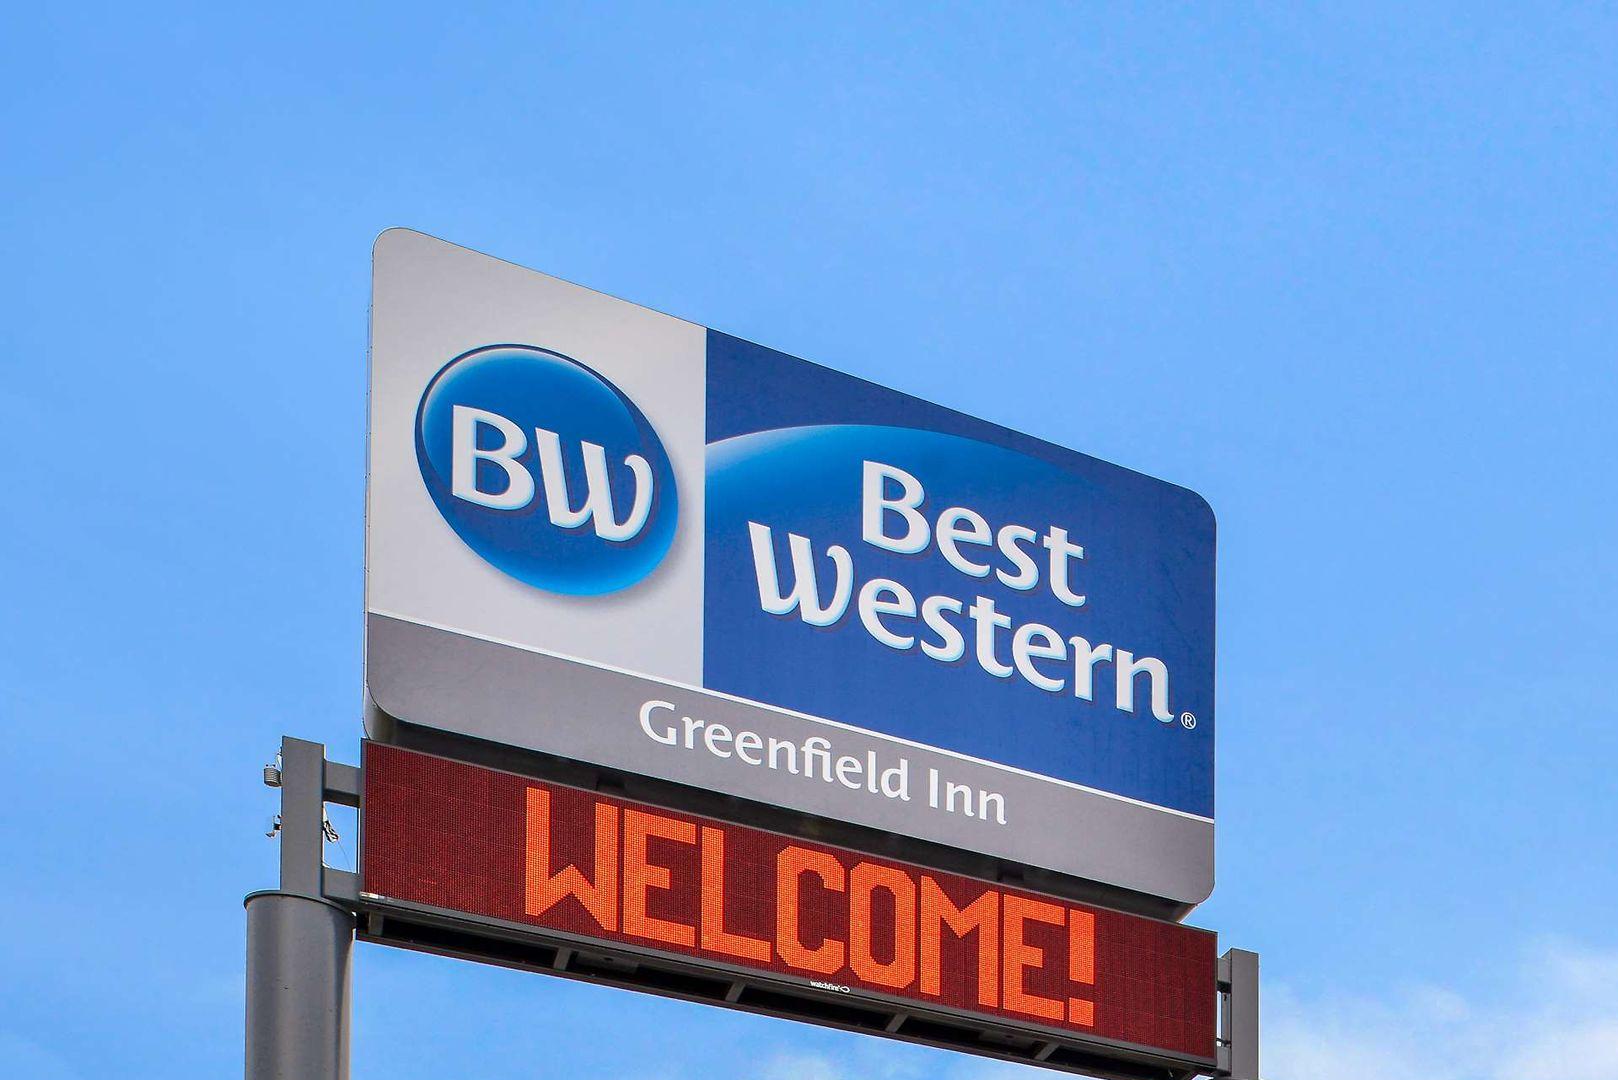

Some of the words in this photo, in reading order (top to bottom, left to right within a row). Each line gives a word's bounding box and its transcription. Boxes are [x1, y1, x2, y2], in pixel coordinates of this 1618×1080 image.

[450, 404, 655, 543] BW
[862, 459, 1086, 608] Best
[747, 520, 1175, 724] Western
[639, 699, 911, 803] Greenfield
[928, 768, 1007, 827] Inn
[524, 787, 1096, 1028] WELCOME!
